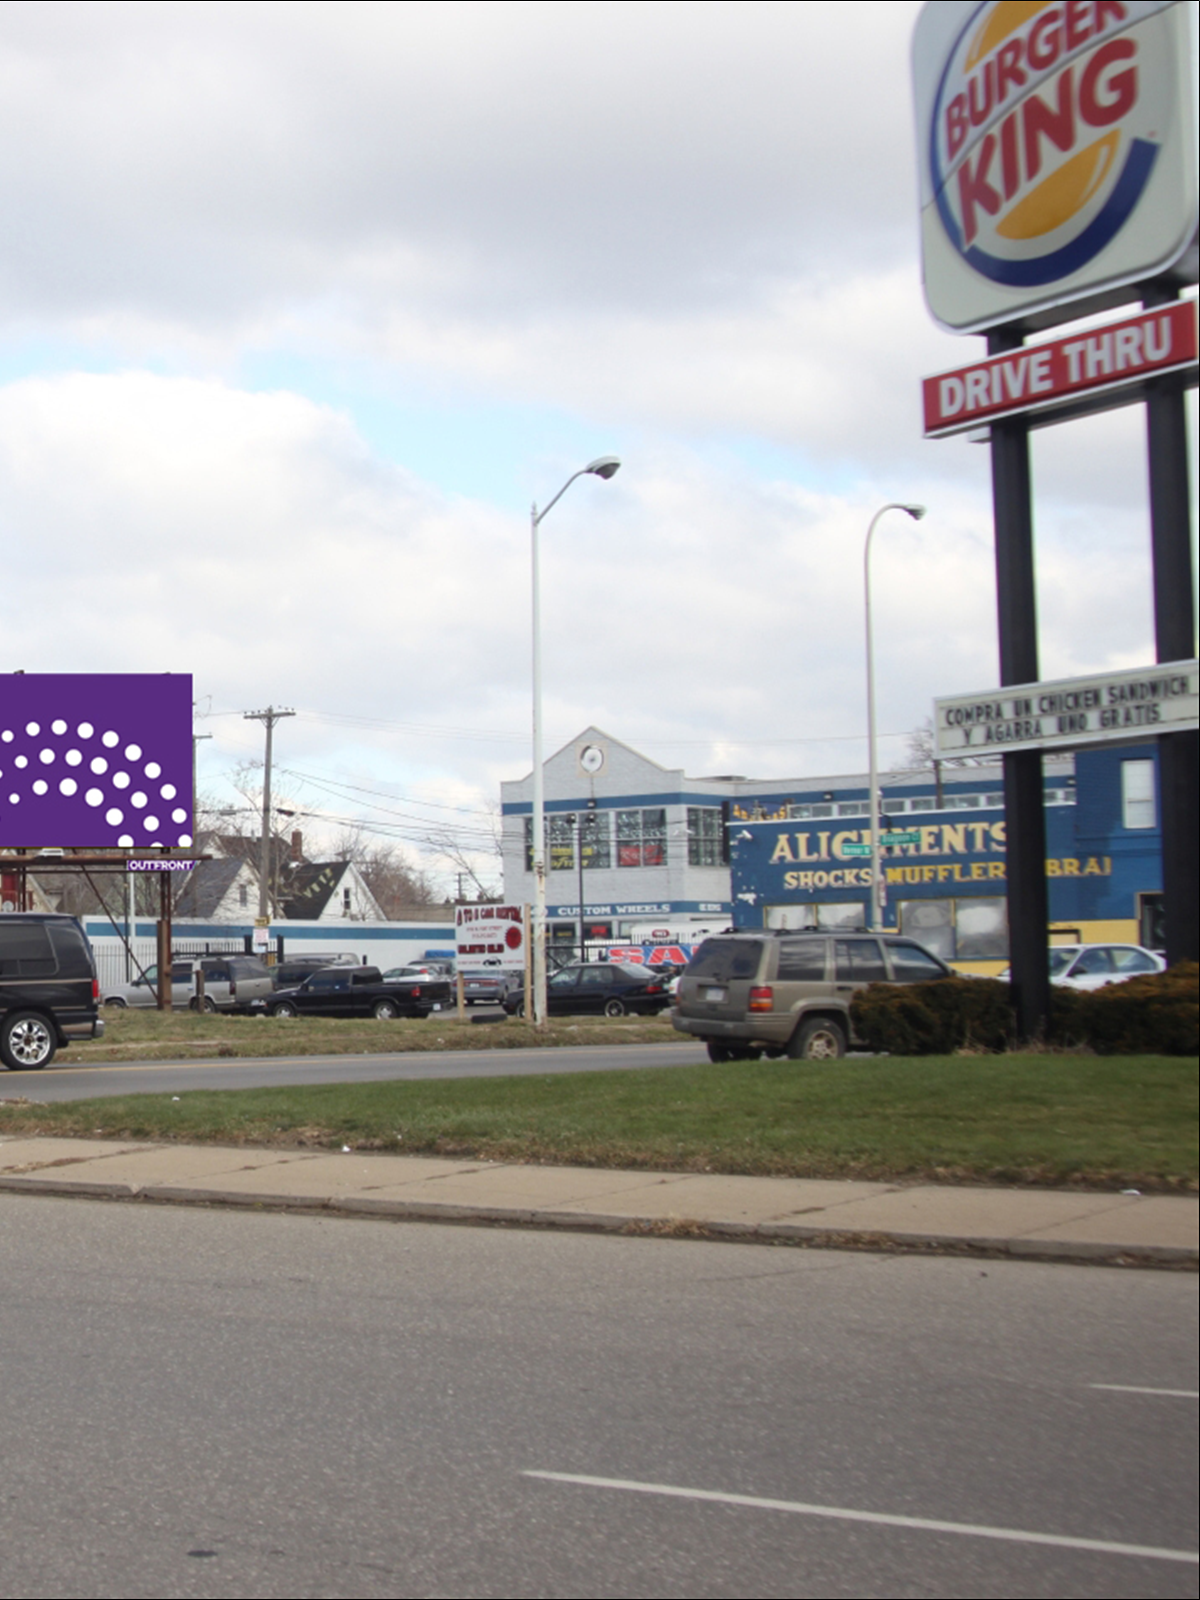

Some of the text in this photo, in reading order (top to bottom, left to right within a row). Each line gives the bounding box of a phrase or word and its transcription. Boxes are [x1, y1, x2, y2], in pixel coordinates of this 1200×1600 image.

[957, 37, 1139, 248] KING
[938, 316, 1173, 418] DRIVE THRU
[945, 675, 1189, 727] COMPRA UN CHICKEN SANDWICH
[963, 702, 1161, 745] Y AGARRA UNO GRATIS
[129, 860, 193, 870] OUTFRONT
[784, 867, 873, 890] SHOCKS
[557, 903, 671, 916] CUSTOM WHEELS
